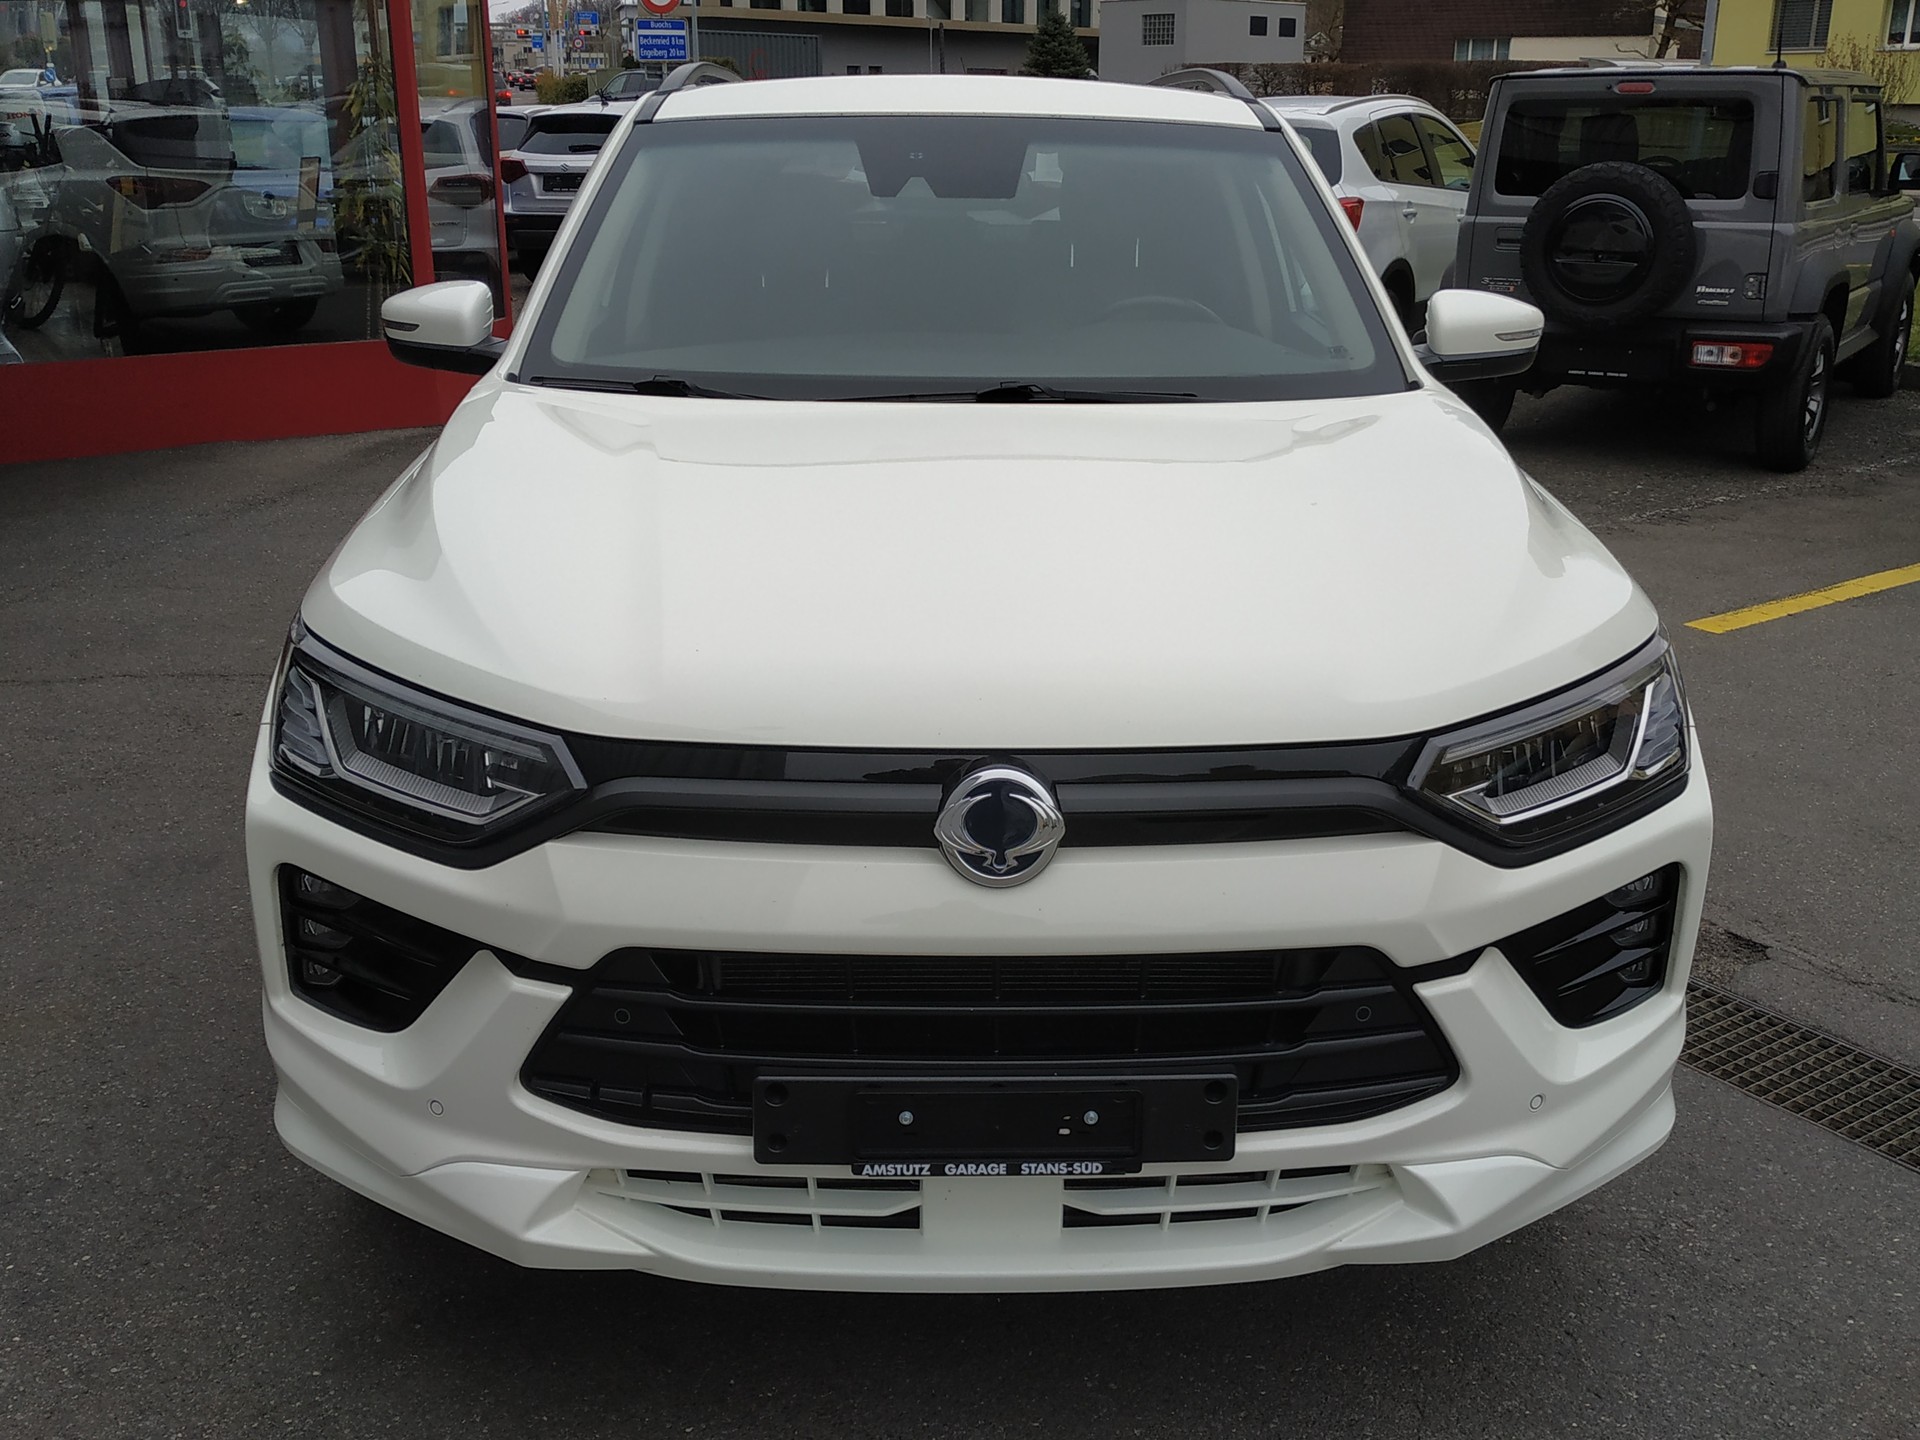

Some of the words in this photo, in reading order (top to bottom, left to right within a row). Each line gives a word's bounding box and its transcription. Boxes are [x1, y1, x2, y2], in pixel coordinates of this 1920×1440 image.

[650, 21, 672, 29] Buochs
[640, 36, 670, 45] Beckenried
[671, 36, 676, 45] 8
[676, 36, 685, 45] km
[640, 48, 668, 58] Engelberg
[669, 48, 676, 57] 20
[677, 48, 685, 56] km
[862, 1164, 931, 1176] AMSTUTZ
[944, 1163, 1007, 1176] GARAGE
[1020, 1161, 1103, 1175] STANS-SÜD
